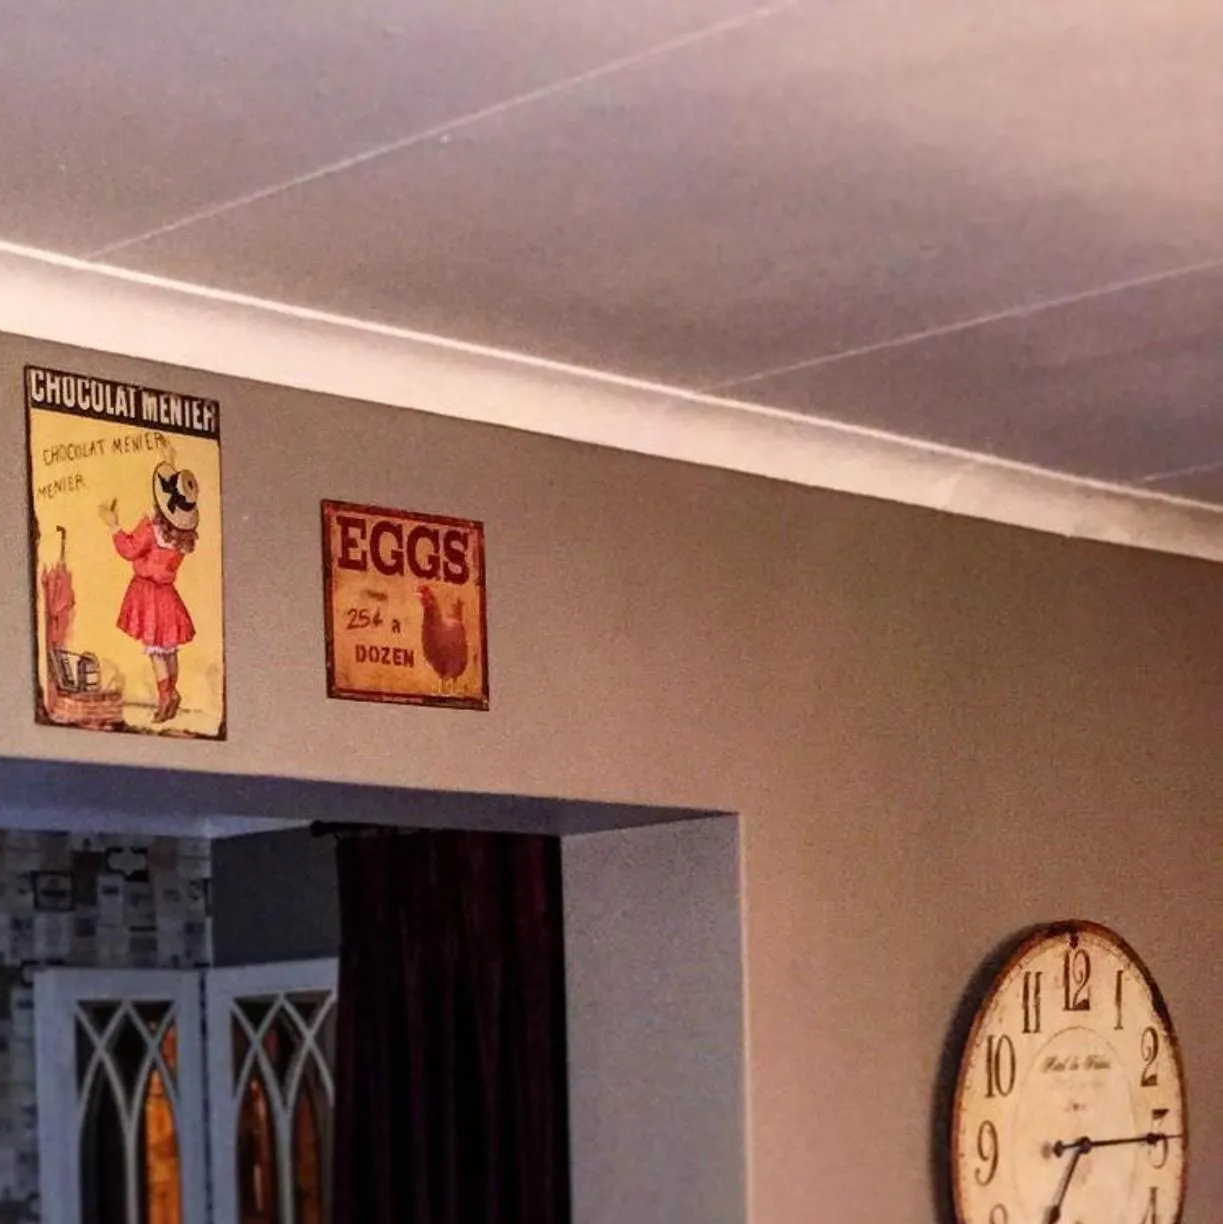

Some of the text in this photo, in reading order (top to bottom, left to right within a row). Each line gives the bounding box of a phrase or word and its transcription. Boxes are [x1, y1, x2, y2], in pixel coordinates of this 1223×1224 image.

[30, 369, 216, 432] CHOCOLAT MENIER
[43, 432, 164, 465] CHOCOLAT MENIER
[38, 474, 85, 499] MENIER
[336, 516, 470, 584] EGGS
[355, 644, 415, 668] DOZEN
[1022, 971, 1042, 1033] 11
[1063, 949, 1091, 1011] 12
[1113, 970, 1124, 1030] 1
[984, 1034, 1016, 1098] 10
[1140, 1026, 1159, 1087] 2
[975, 1120, 999, 1186] 9
